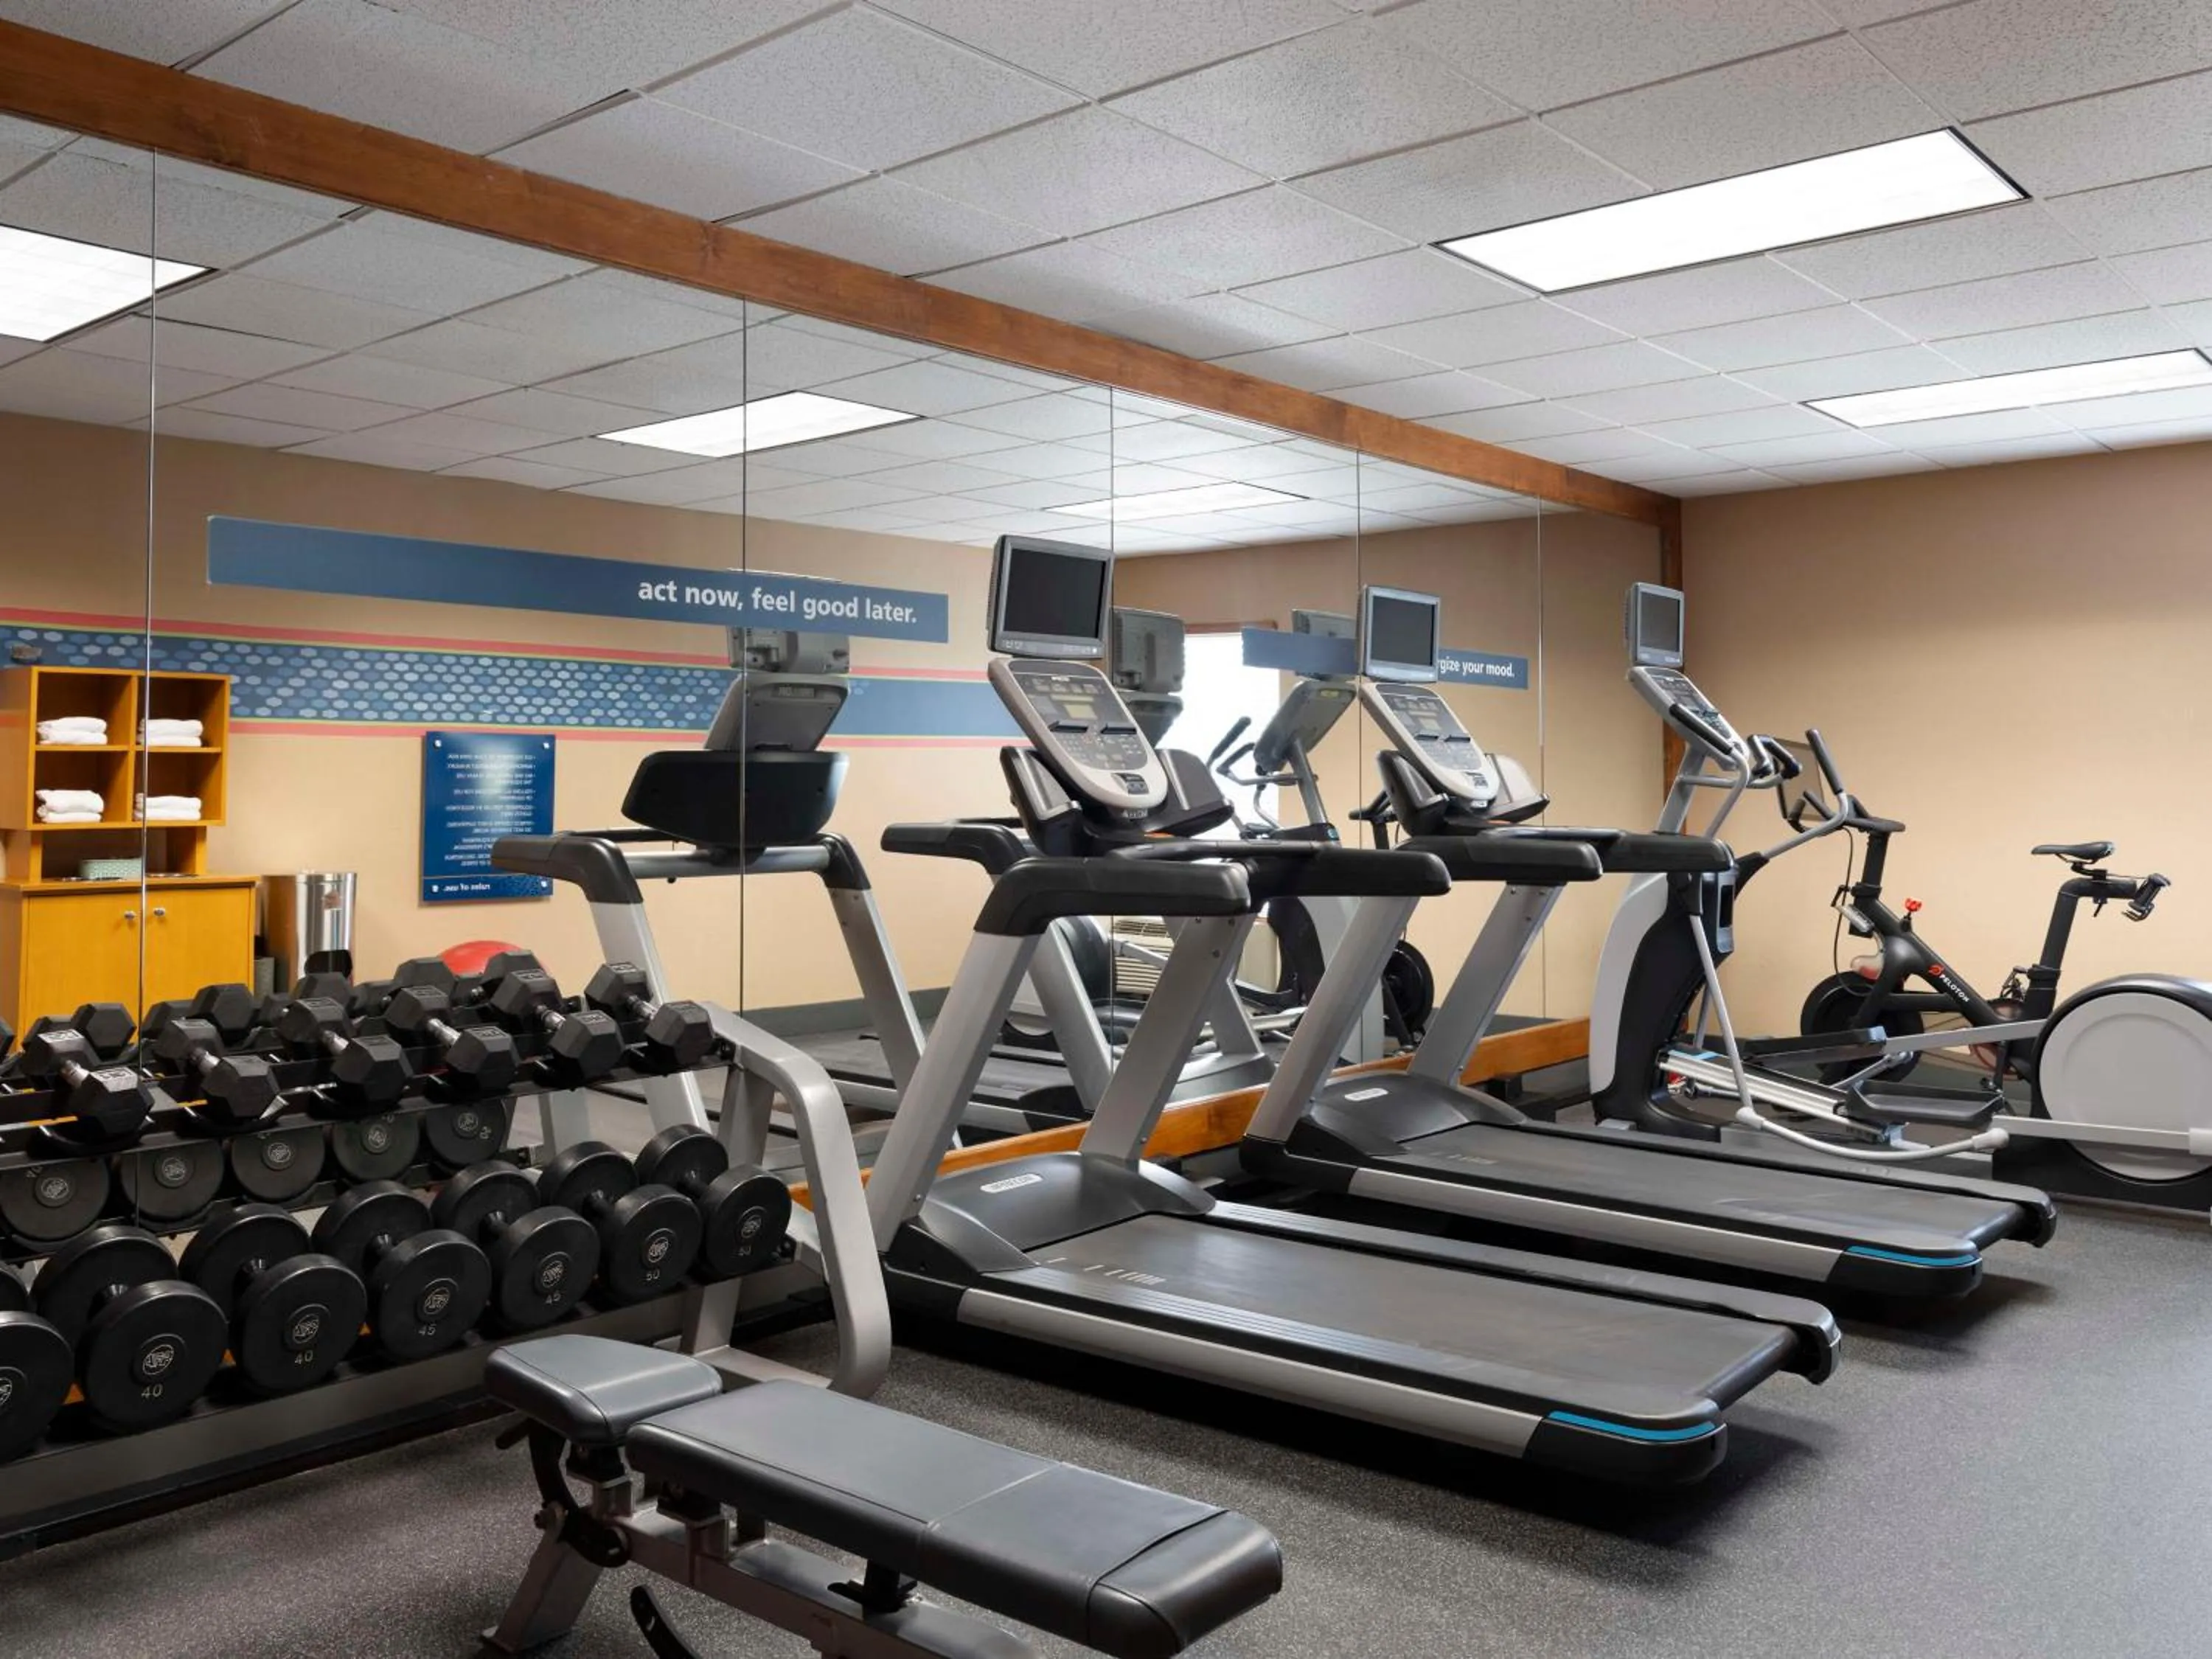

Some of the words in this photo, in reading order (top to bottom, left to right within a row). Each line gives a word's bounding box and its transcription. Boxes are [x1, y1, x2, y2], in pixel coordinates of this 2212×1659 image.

[638, 580, 678, 602] act
[685, 585, 743, 611] now,
[751, 587, 796, 613] feel
[803, 597, 858, 620] good
[865, 597, 917, 623] later.
[1462, 661, 1484, 676] your
[1486, 663, 1515, 678] mood.
[1939, 974, 1969, 1002] PELOTON
[418, 1324, 437, 1336] 45
[294, 1350, 313, 1364] 40
[141, 1384, 163, 1398] 40
